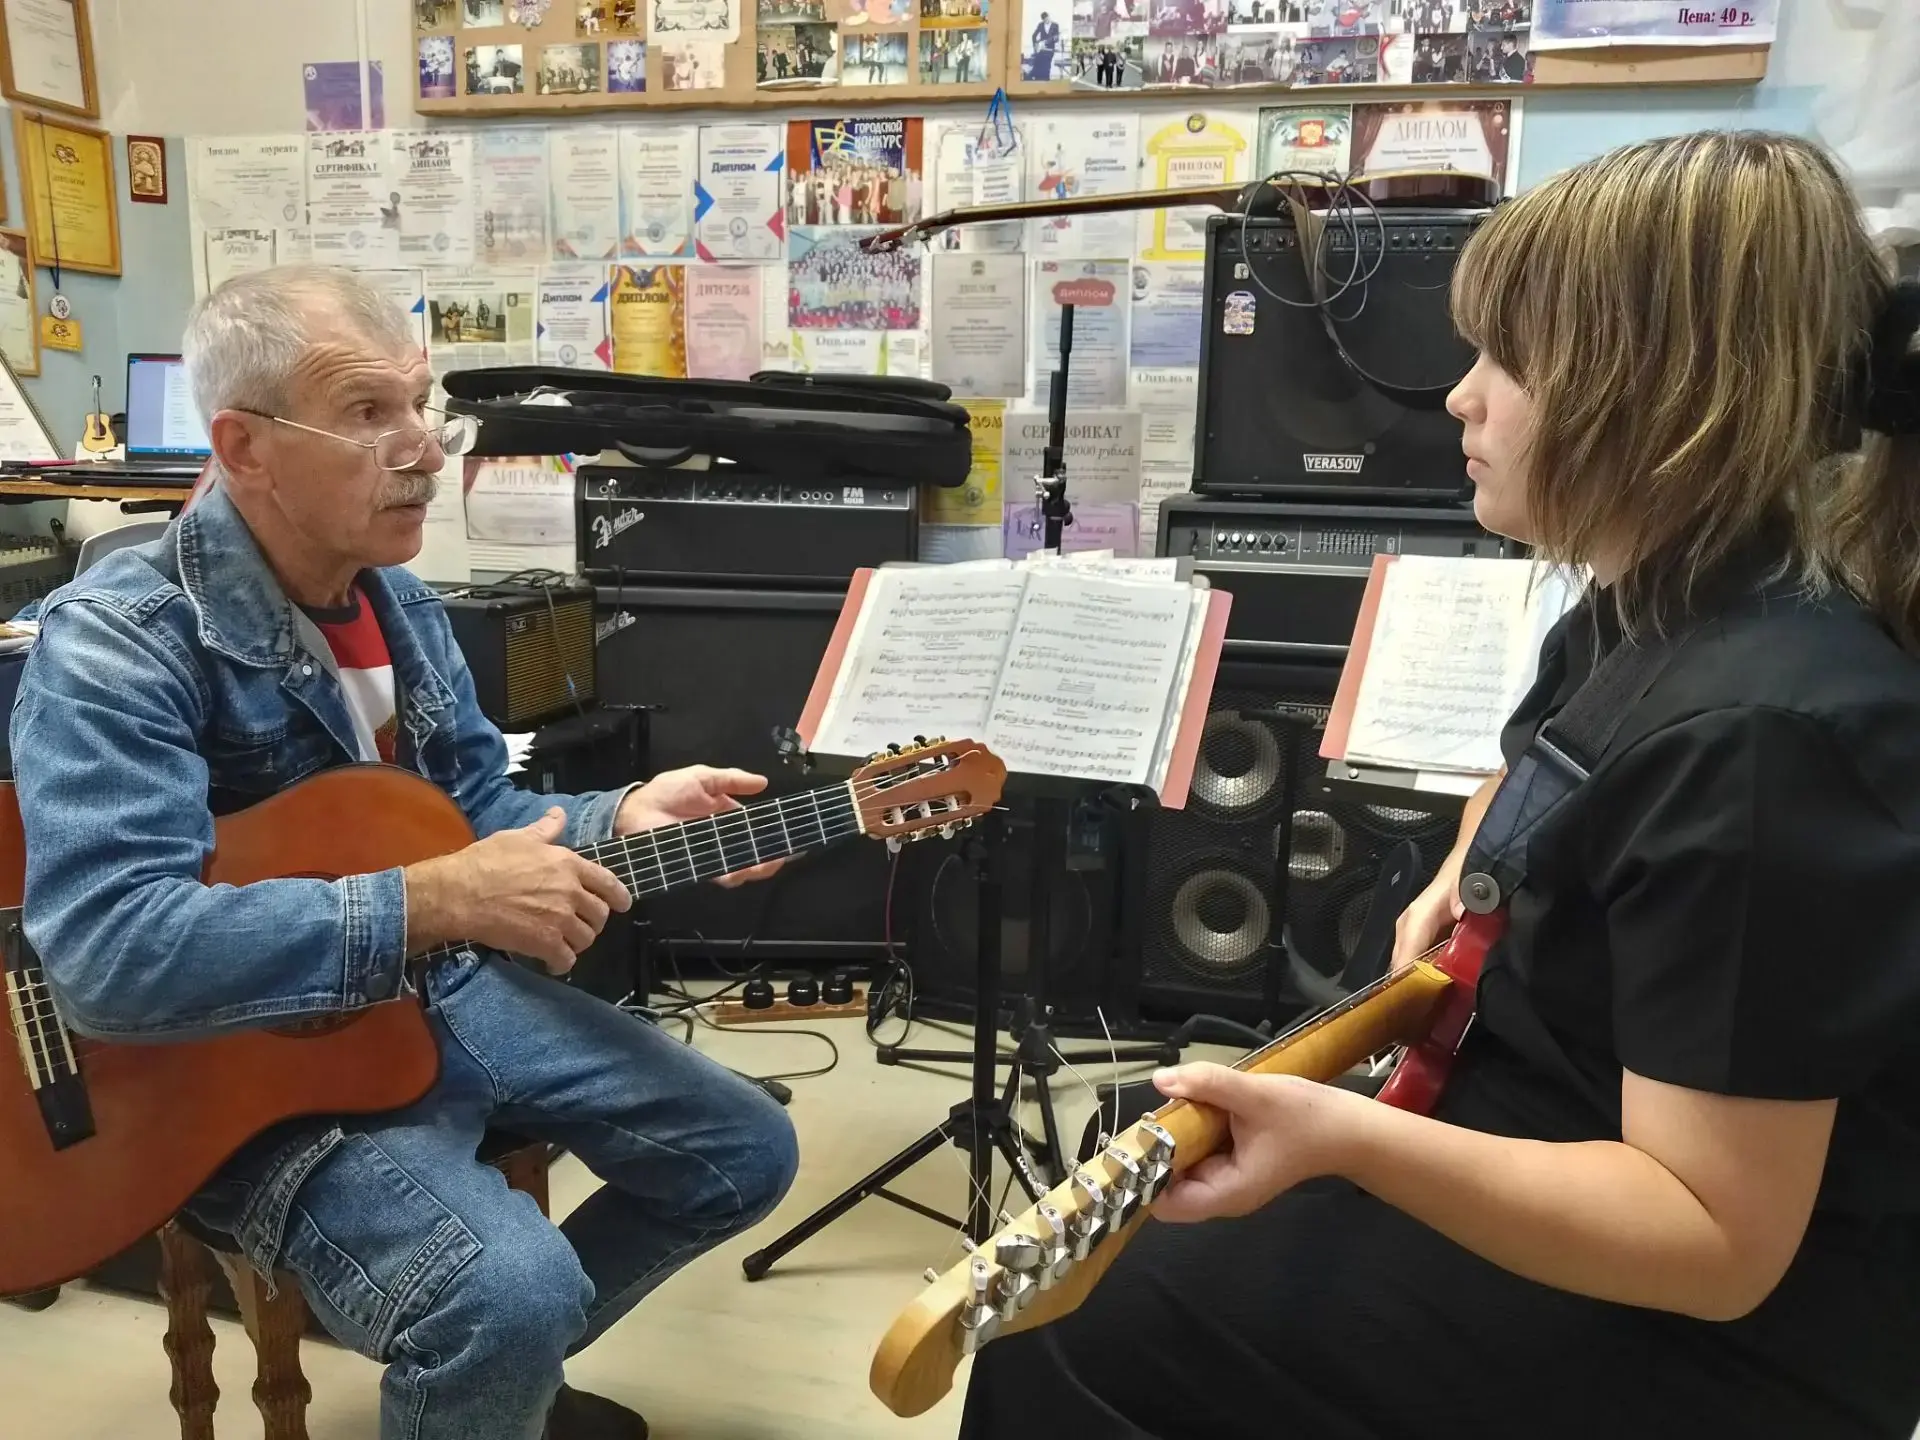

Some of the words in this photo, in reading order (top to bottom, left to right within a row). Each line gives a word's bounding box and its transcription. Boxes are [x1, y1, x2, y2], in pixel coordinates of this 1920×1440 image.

[1678, 8, 1716, 25] Цена:
[1720, 8, 1737, 24] 40
[1741, 9, 1755, 25] р.
[854, 120, 903, 134] ГОРОДСКОЙ
[1391, 119, 1468, 143] ДИПЛОМ
[854, 134, 903, 149] КОНКУРС
[315, 163, 377, 172] СЕРТИФИКАТ
[711, 162, 756, 173] Диплом
[1169, 160, 1223, 171] ДИПЛОМ
[541, 292, 582, 304] Диплом
[616, 292, 669, 305] ДИПЛОМ
[1060, 287, 1109, 298] ДИПЛОМ
[1306, 456, 1362, 471] YERASOV
[843, 487, 863, 497] FM
[592, 507, 645, 549] Fender
